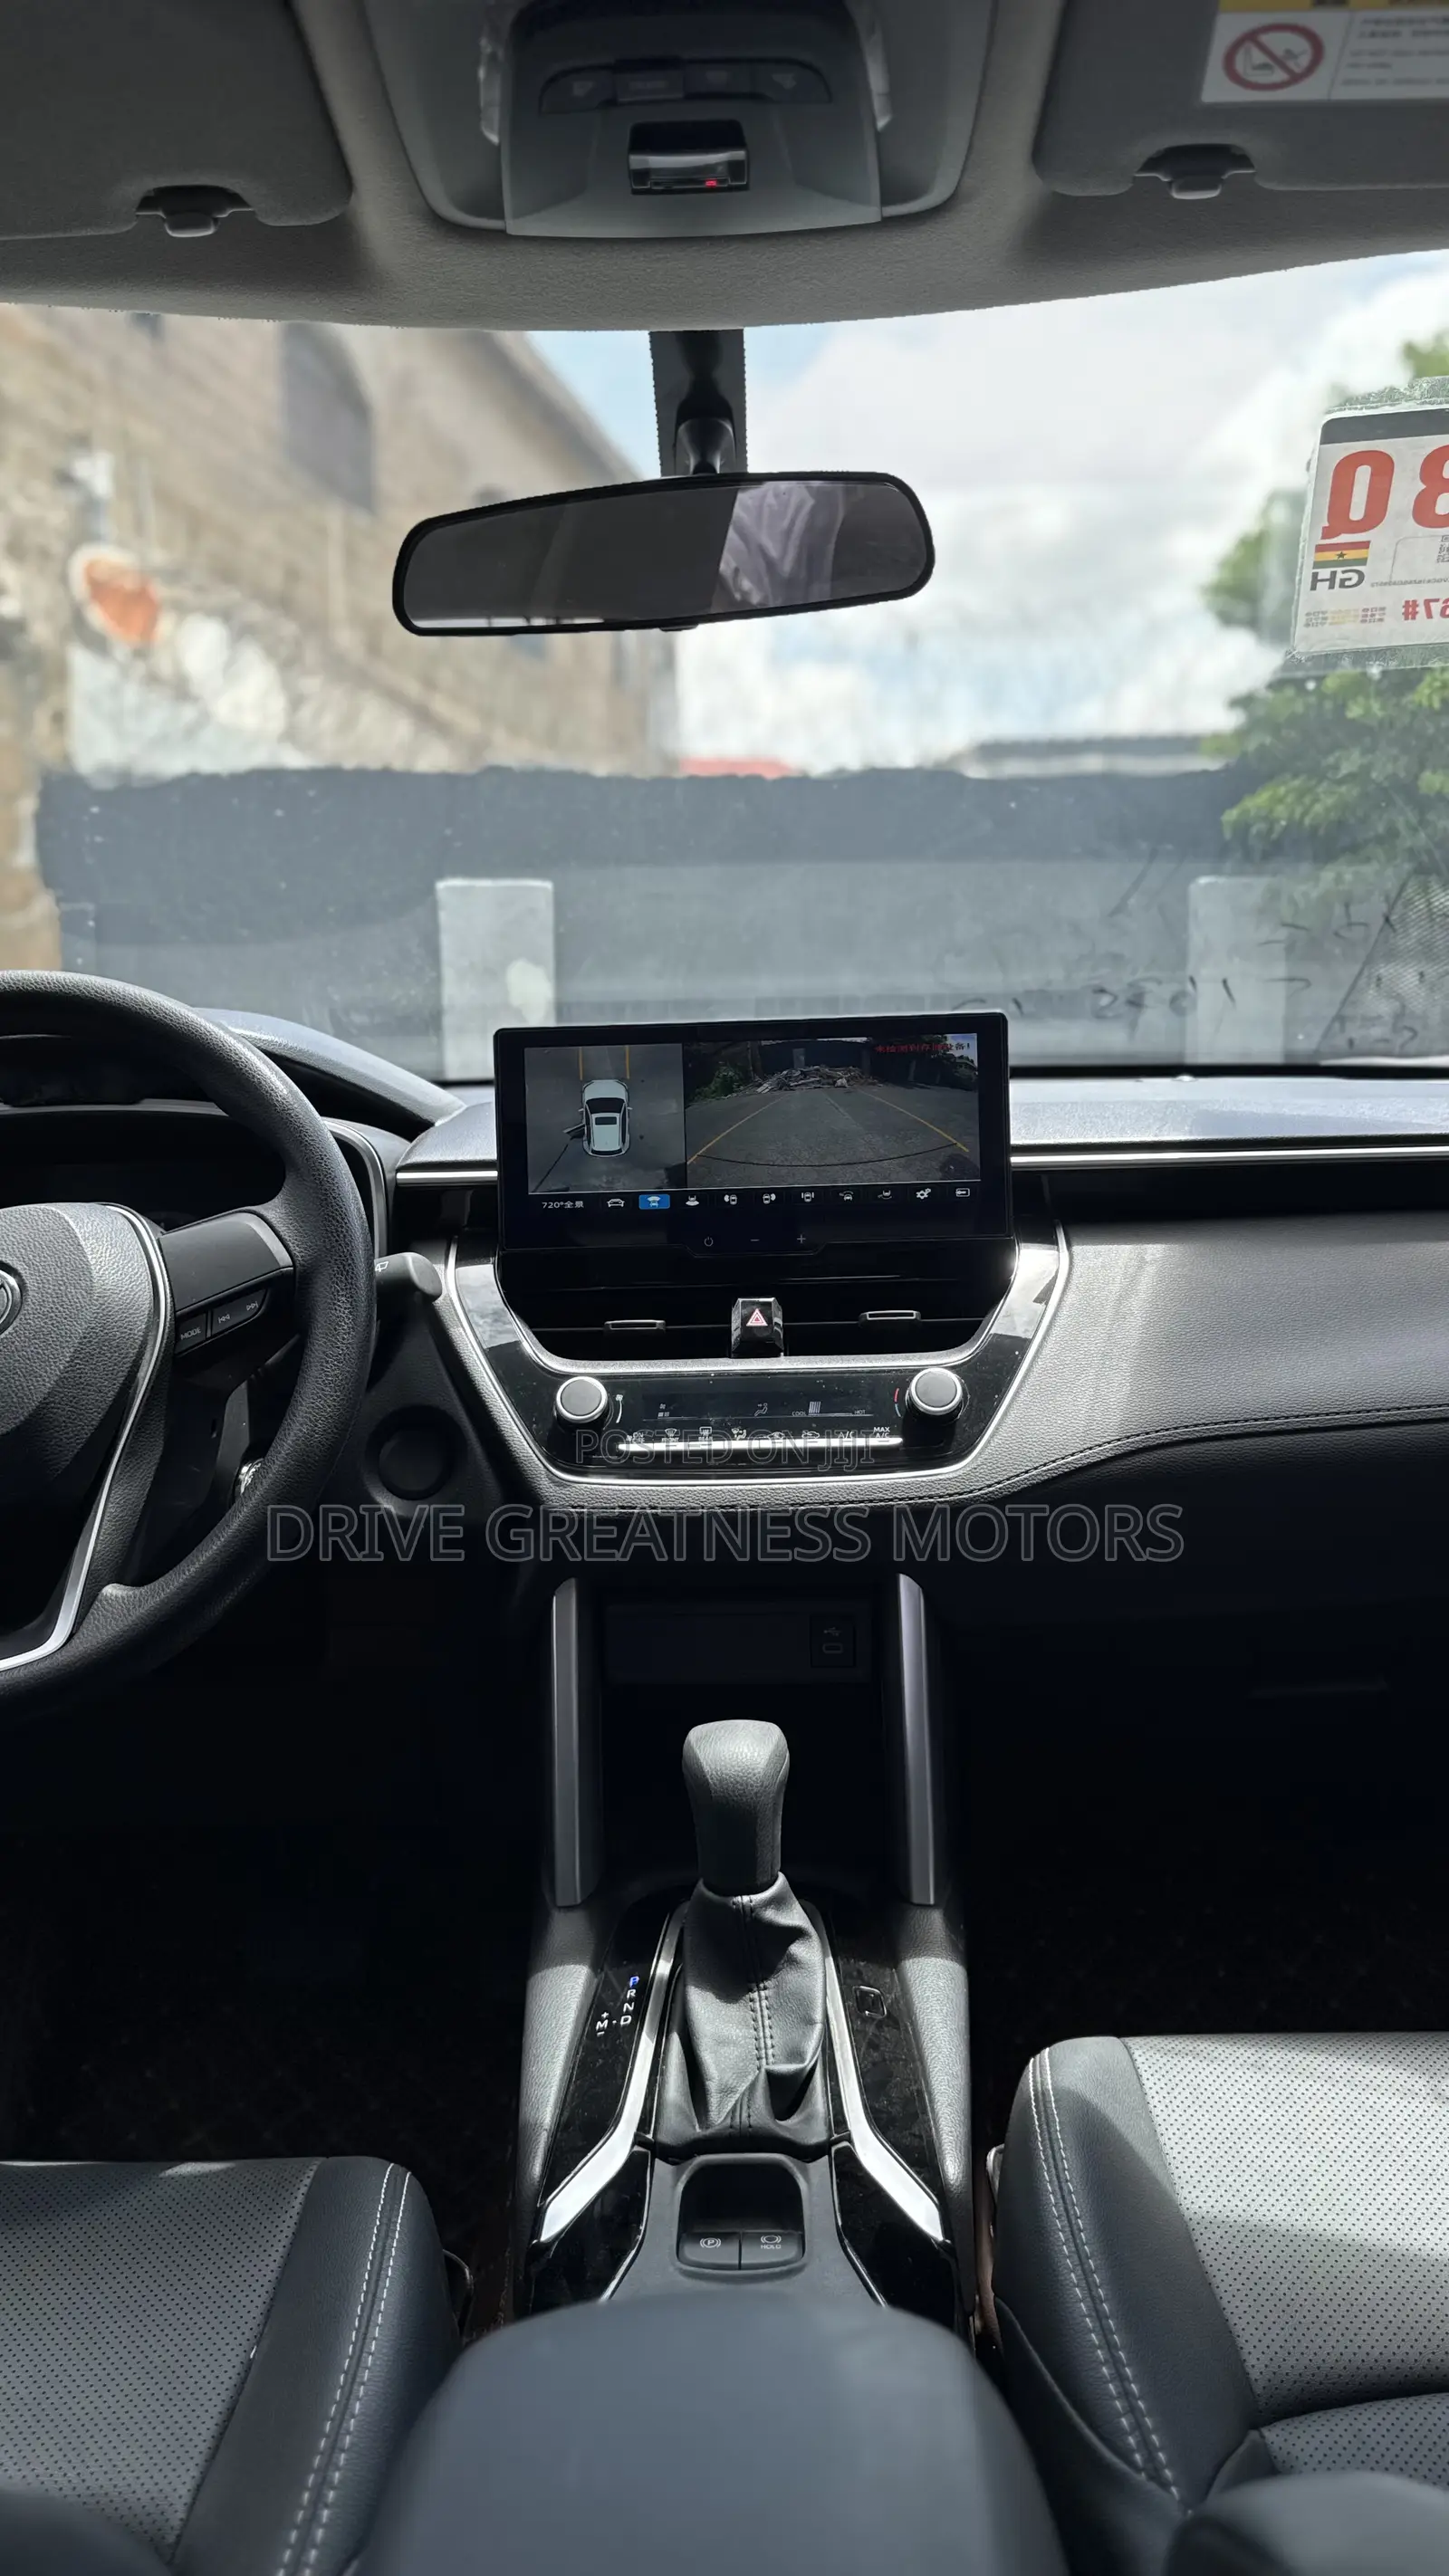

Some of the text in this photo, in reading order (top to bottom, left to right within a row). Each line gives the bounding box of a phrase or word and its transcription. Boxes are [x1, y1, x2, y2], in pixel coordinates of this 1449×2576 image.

[180, 1326, 202, 1340] MODE
[629, 1976, 639, 1988] P
[627, 1989, 637, 1999] R
[623, 2002, 635, 2013] N
[596, 2019, 609, 2031] M
[620, 2016, 632, 2026] D
